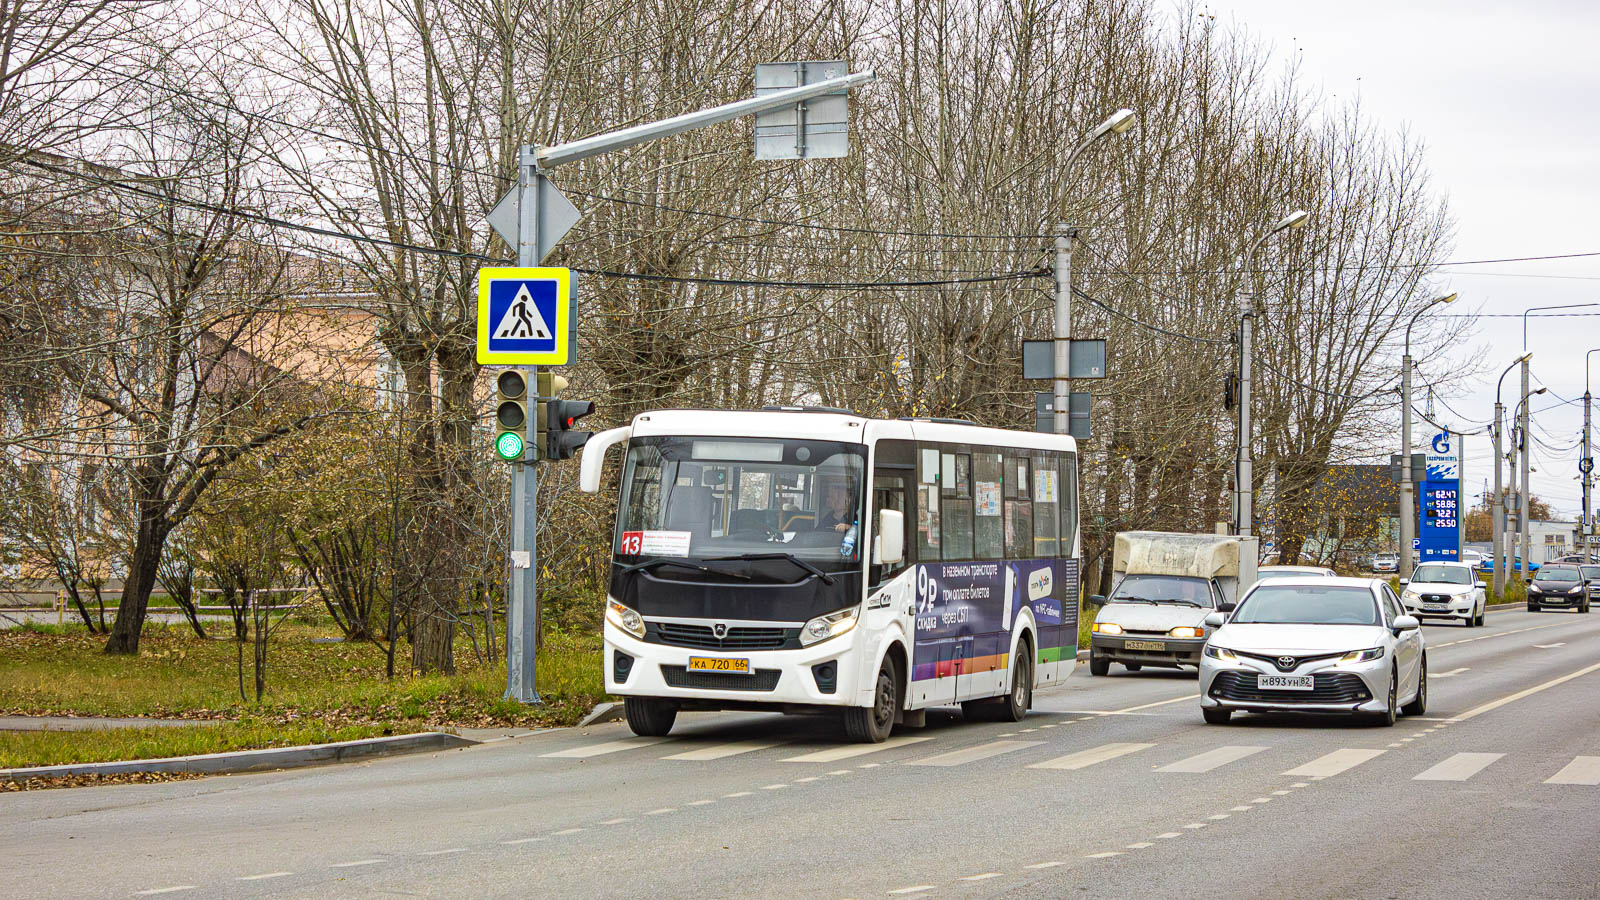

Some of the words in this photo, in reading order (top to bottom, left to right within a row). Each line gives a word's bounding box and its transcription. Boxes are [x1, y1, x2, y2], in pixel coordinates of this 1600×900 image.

[1436, 490, 1456, 498] 62.47
[1436, 500, 1456, 508] 58.86
[1436, 509, 1456, 518] 72.21
[1436, 519, 1456, 528] 25.50
[623, 535, 640, 555] 13
[942, 566, 946, 578] в
[947, 565, 971, 578] наземном
[971, 564, 998, 580] транспорте
[942, 589, 953, 605] при
[953, 588, 970, 600] оплате
[970, 583, 990, 599] билетов
[942, 612, 957, 629] через
[957, 606, 969, 623] СБП
[917, 617, 937, 632] скидка
[711, 659, 730, 670] 720
[735, 659, 745, 668] 66
